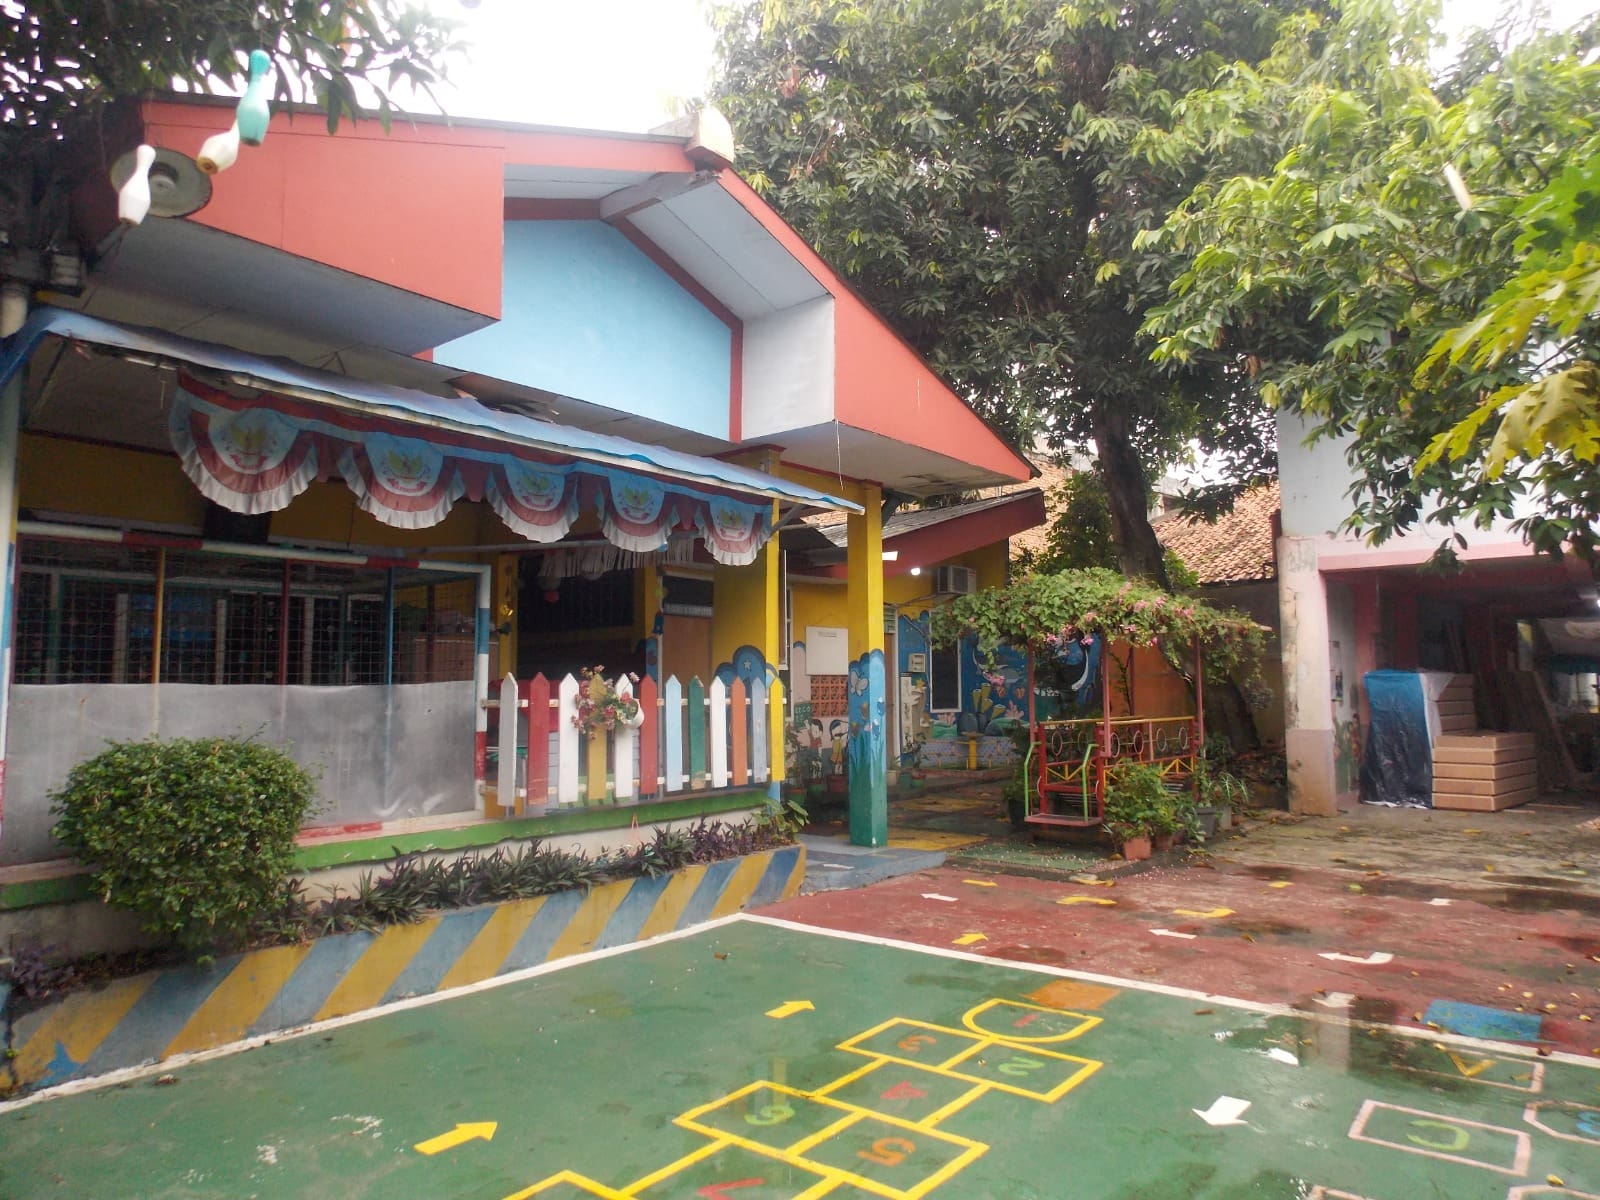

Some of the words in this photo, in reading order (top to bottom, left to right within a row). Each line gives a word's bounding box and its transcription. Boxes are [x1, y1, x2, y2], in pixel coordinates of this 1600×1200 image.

[897, 1034, 938, 1052] 3
[998, 1056, 1046, 1076] 2
[1407, 1119, 1470, 1150] C
[856, 1137, 916, 1167] 5
